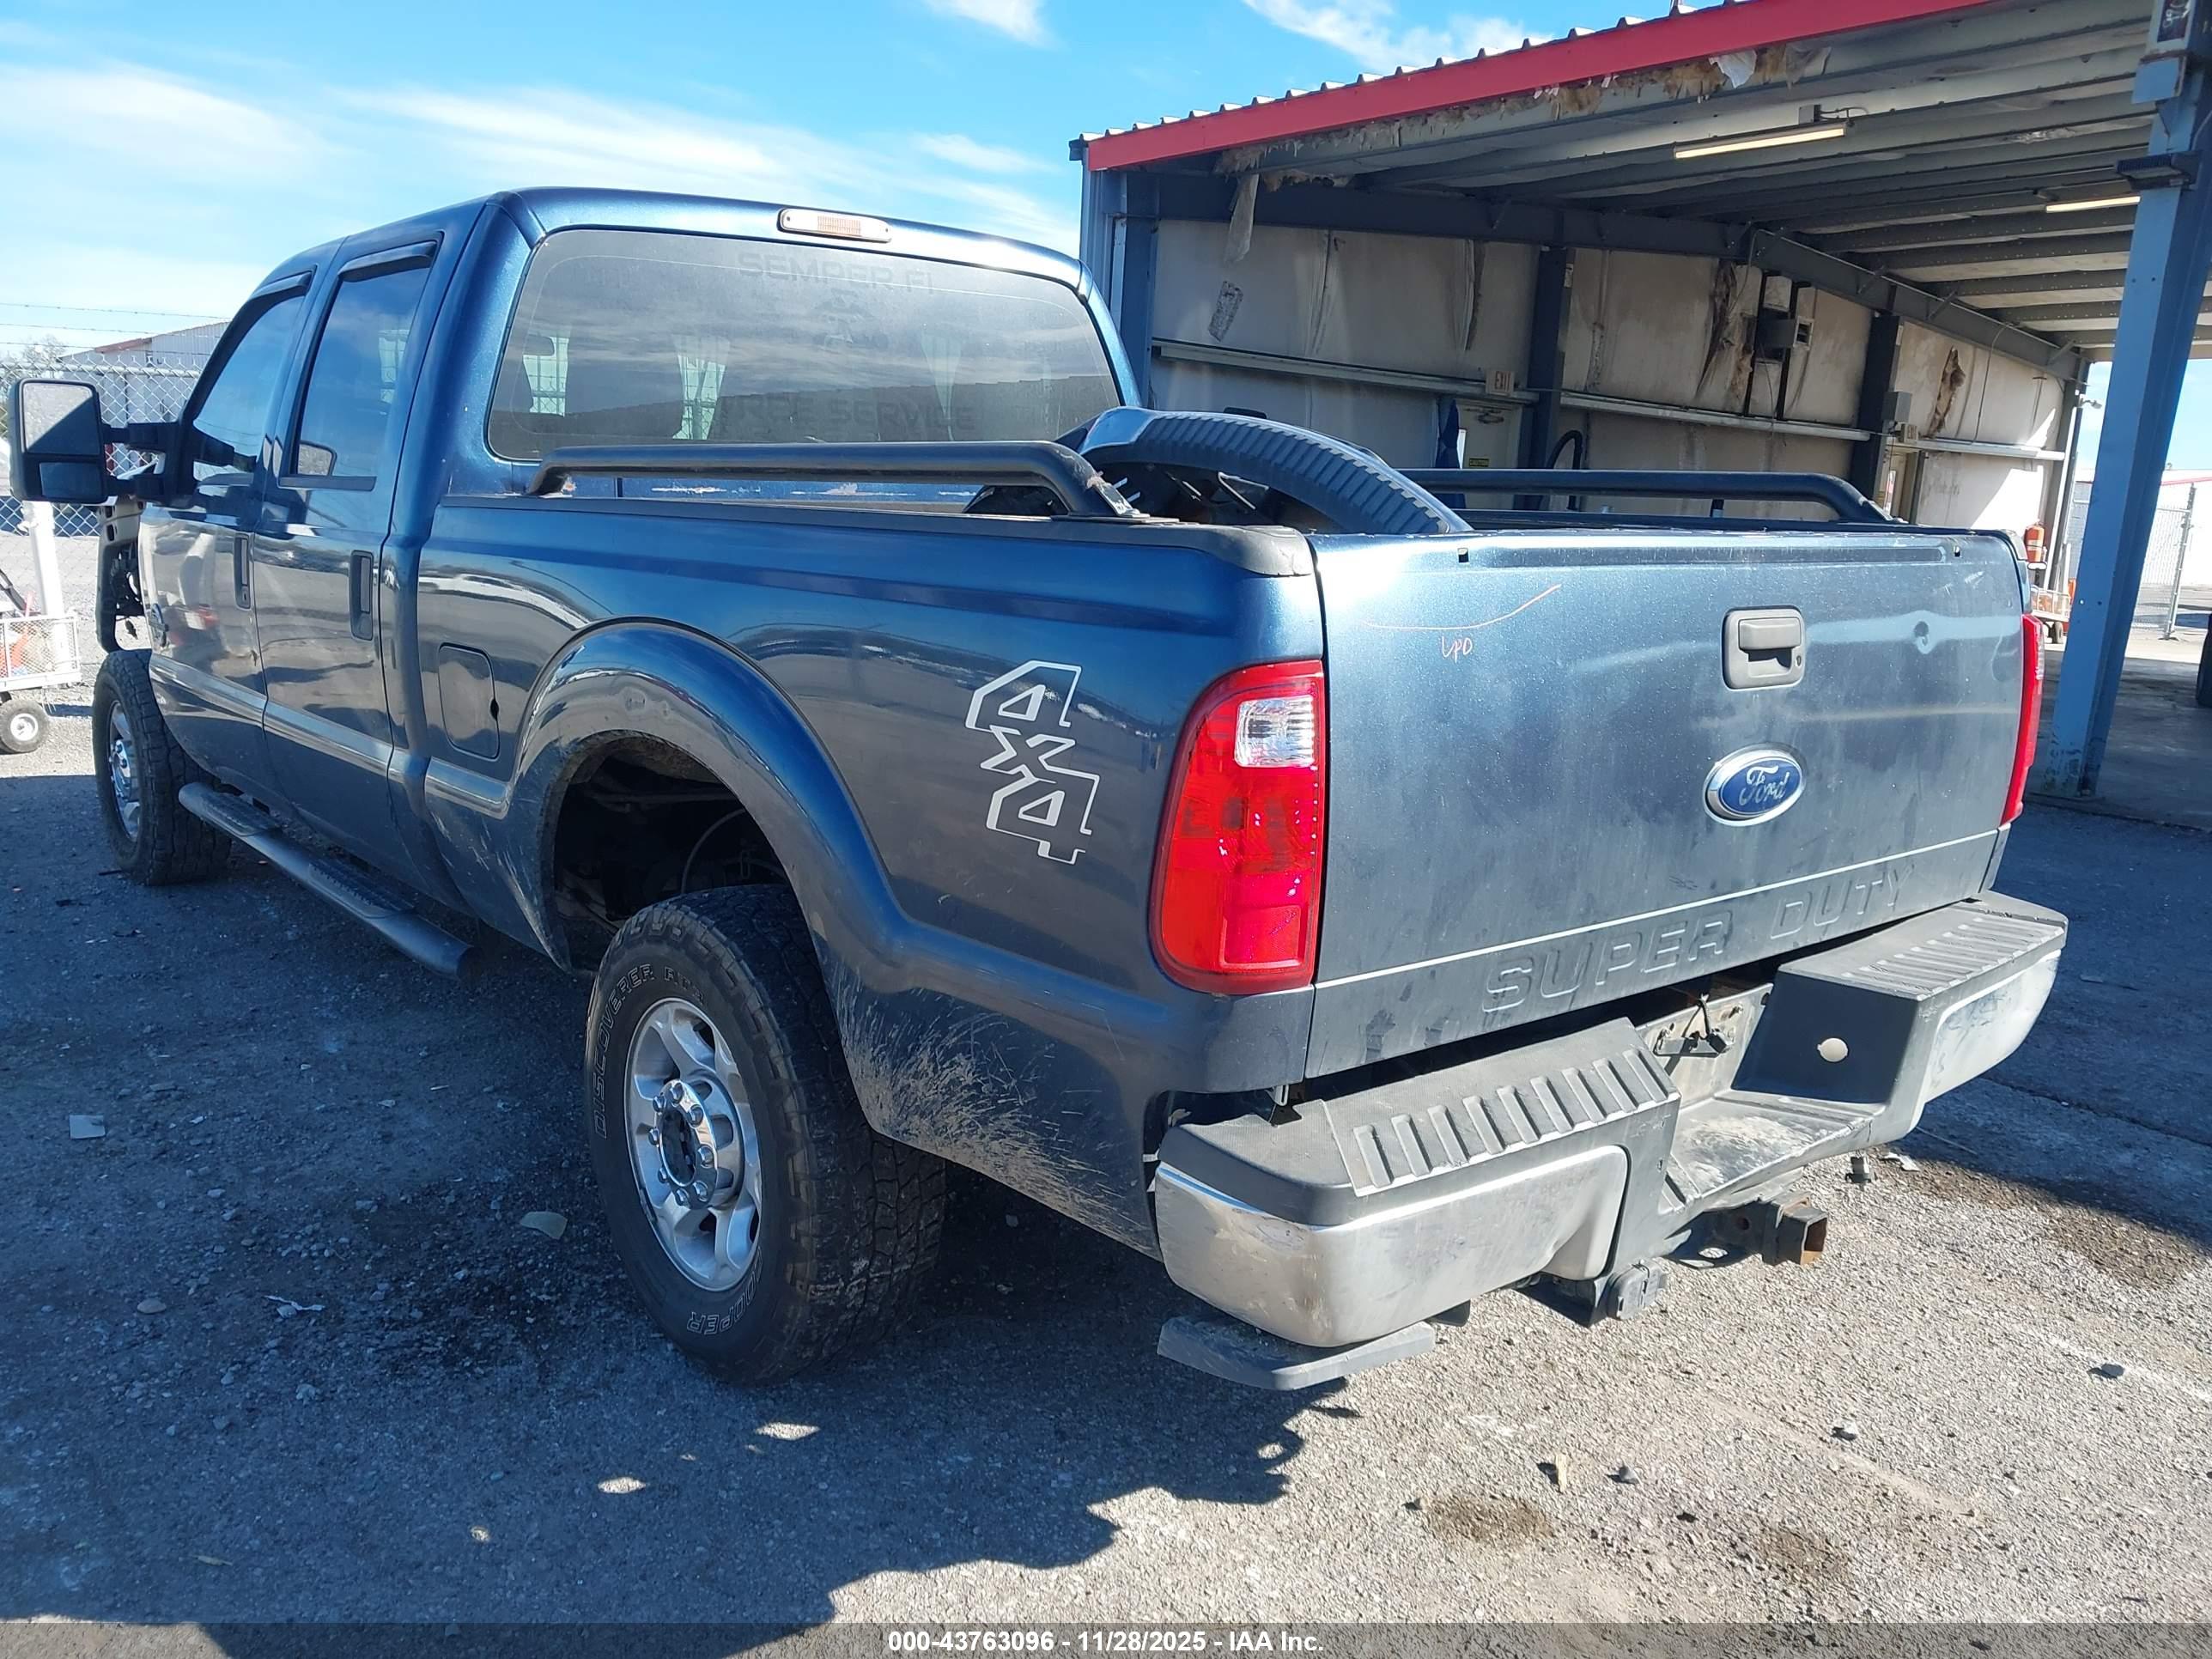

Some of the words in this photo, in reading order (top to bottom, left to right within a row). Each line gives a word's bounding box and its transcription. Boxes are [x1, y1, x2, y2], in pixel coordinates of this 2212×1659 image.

[738, 252, 894, 290] SEMPER
[1739, 765, 1790, 806] Ford
[1482, 908, 1735, 1014] SUPER
[1770, 862, 1916, 940] DUTY
[591, 963, 657, 1140] DISCOVERER
[686, 1245, 763, 1336] COOPER
